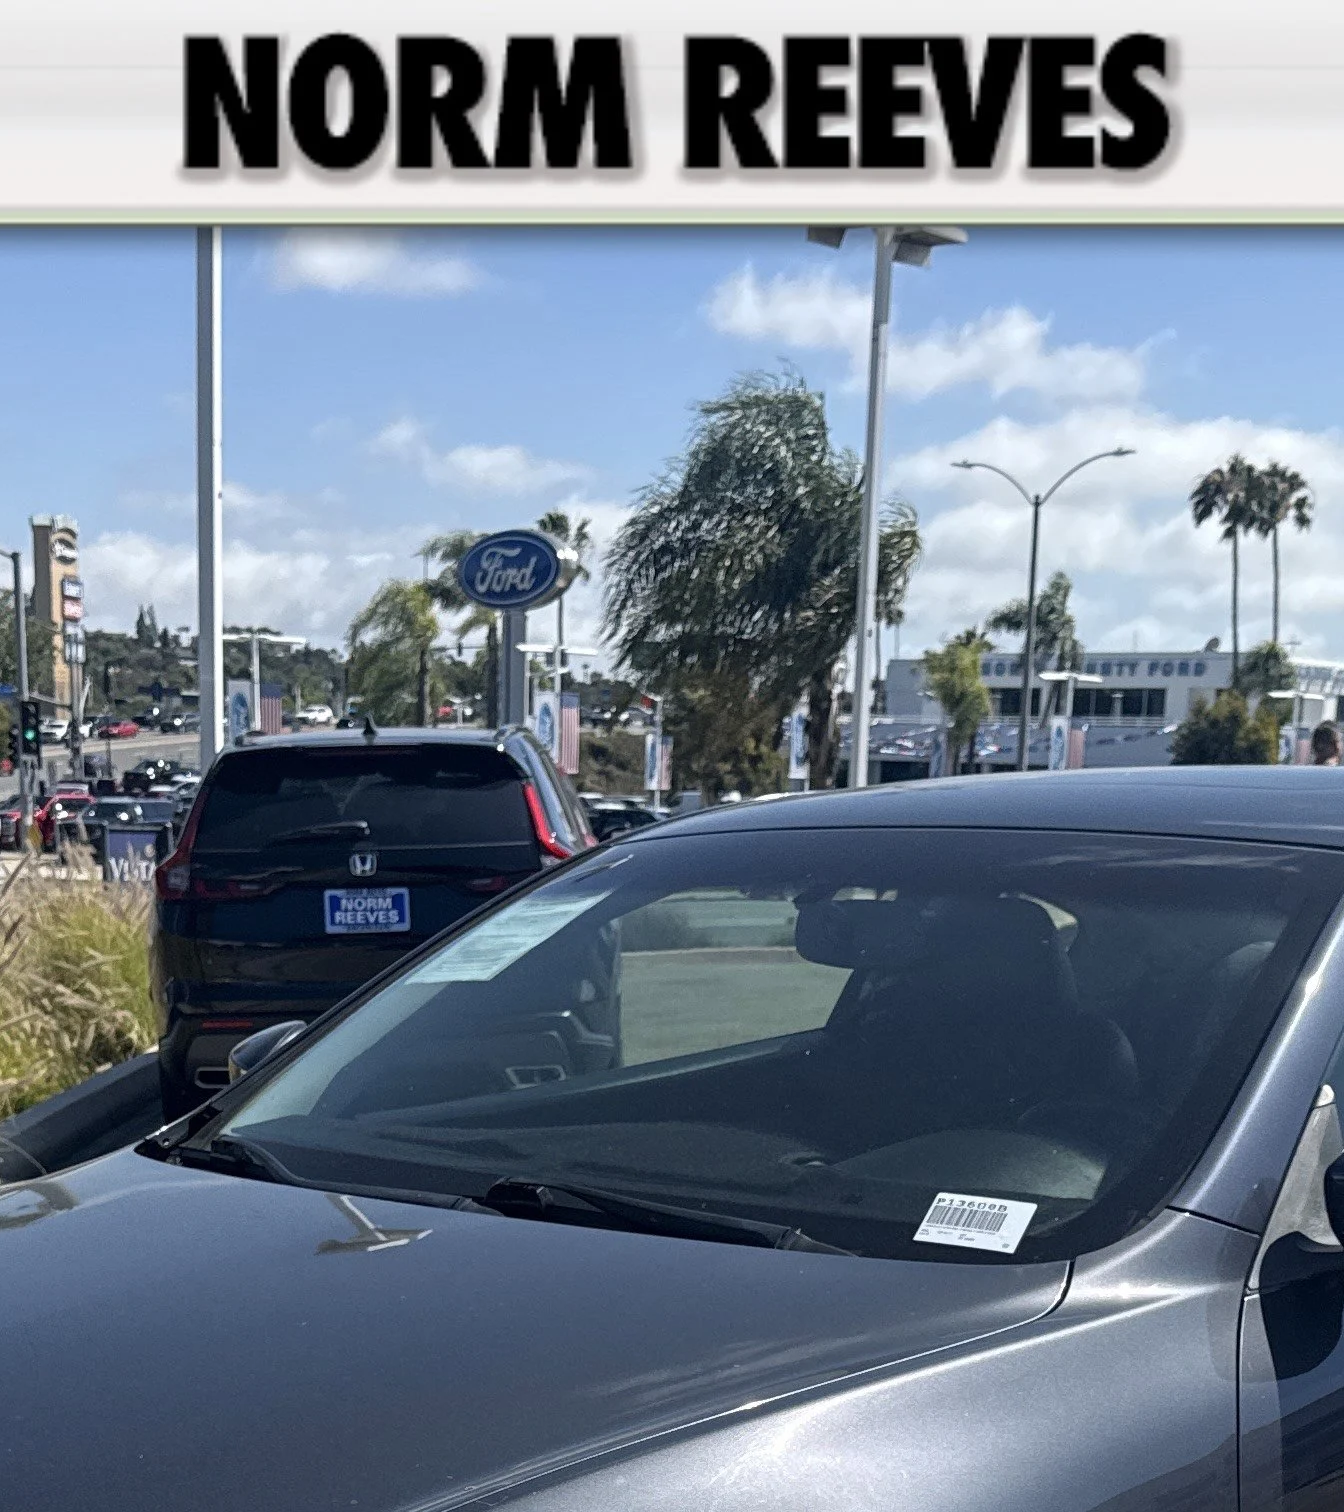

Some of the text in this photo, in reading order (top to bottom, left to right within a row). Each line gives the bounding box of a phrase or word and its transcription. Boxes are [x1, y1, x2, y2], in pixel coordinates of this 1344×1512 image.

[475, 547, 537, 593] Ford
[1147, 661, 1205, 677] FORD
[340, 898, 393, 911] NORM
[335, 910, 399, 924] REEVES
